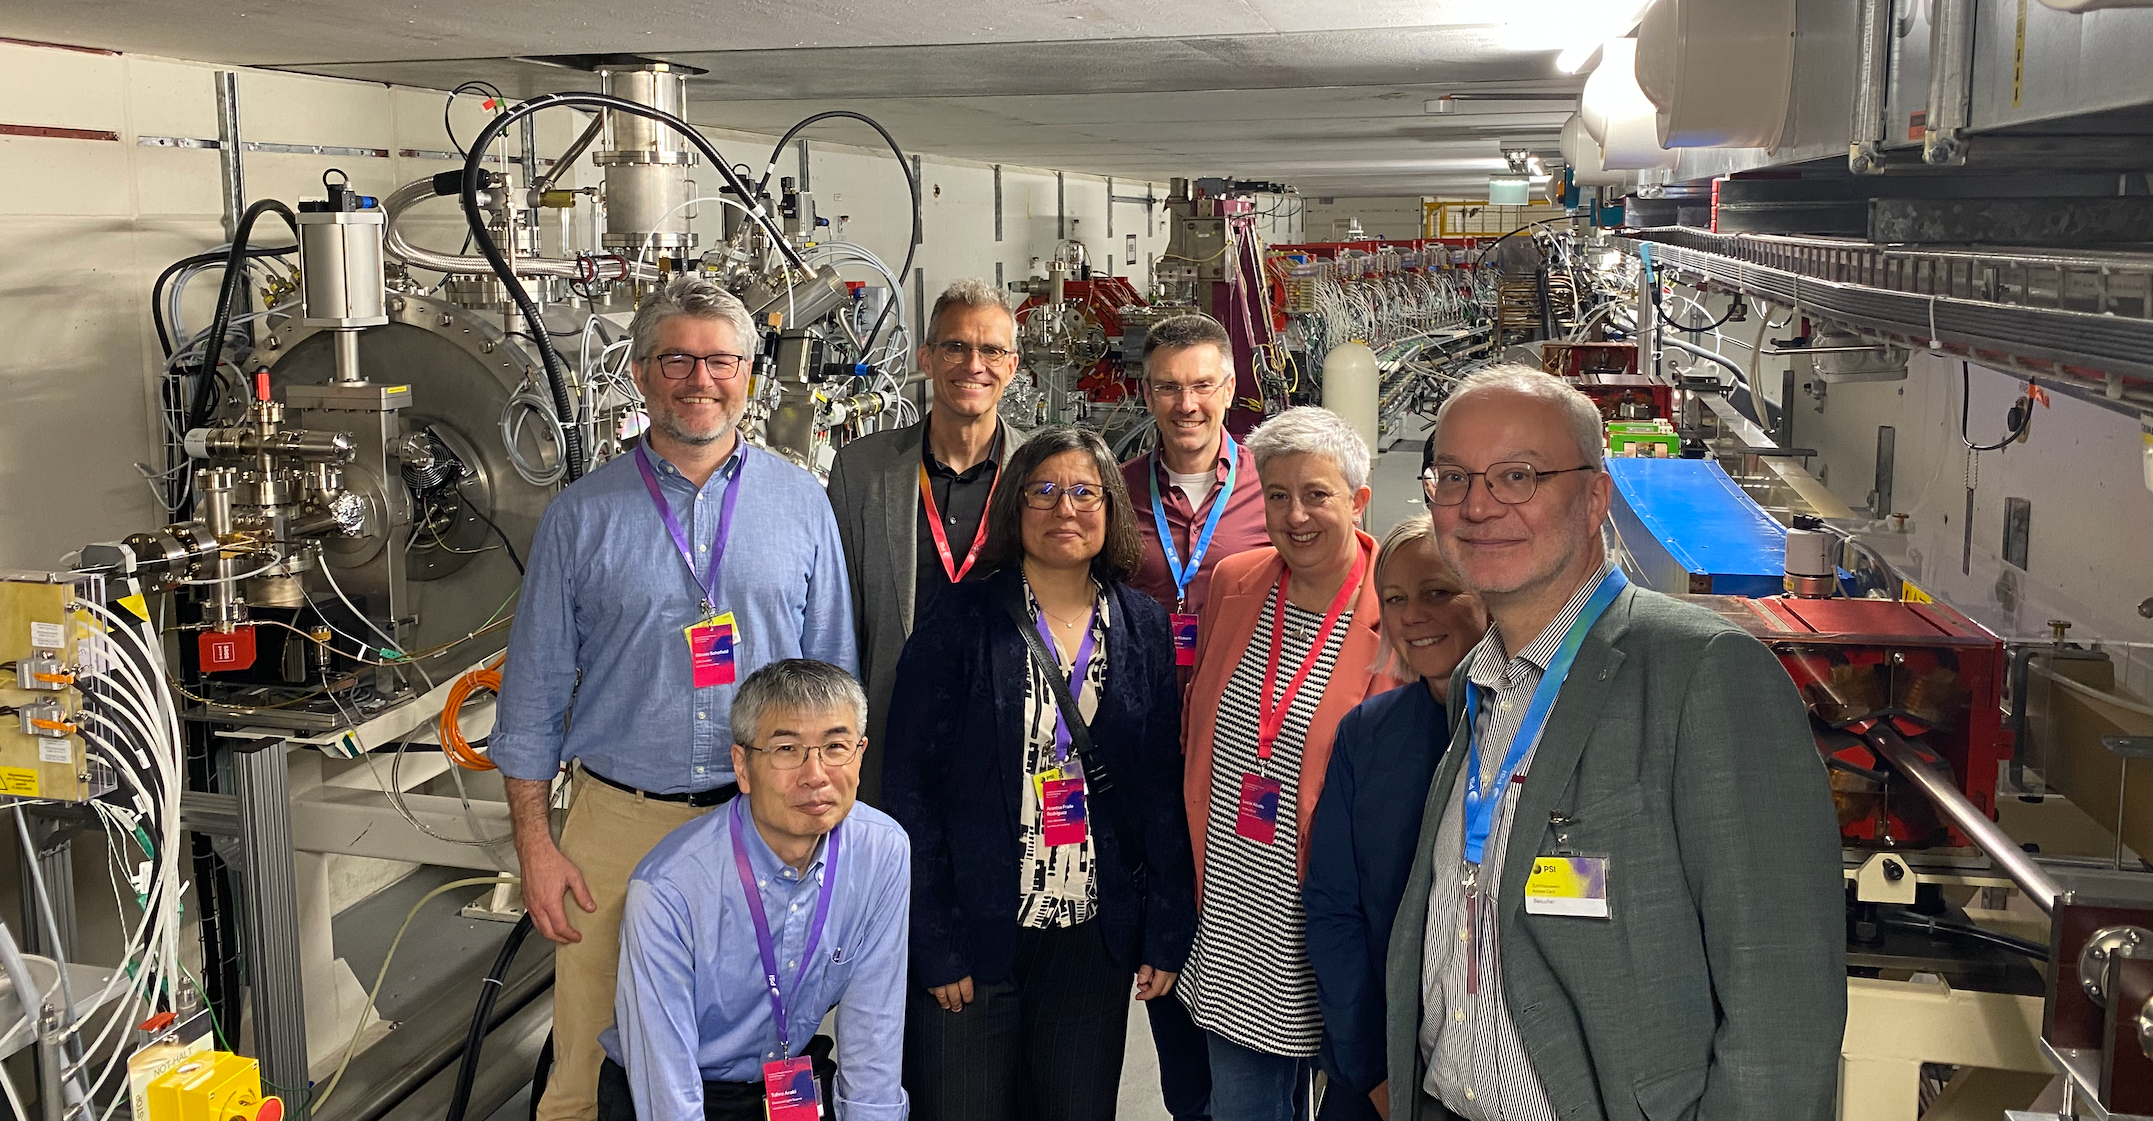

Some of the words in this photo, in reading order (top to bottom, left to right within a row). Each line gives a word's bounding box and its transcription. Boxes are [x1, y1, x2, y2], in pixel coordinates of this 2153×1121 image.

[1497, 770, 1507, 785] PSI
[768, 974, 776, 987] PSI
[153, 1046, 193, 1077] NOT-HALT
